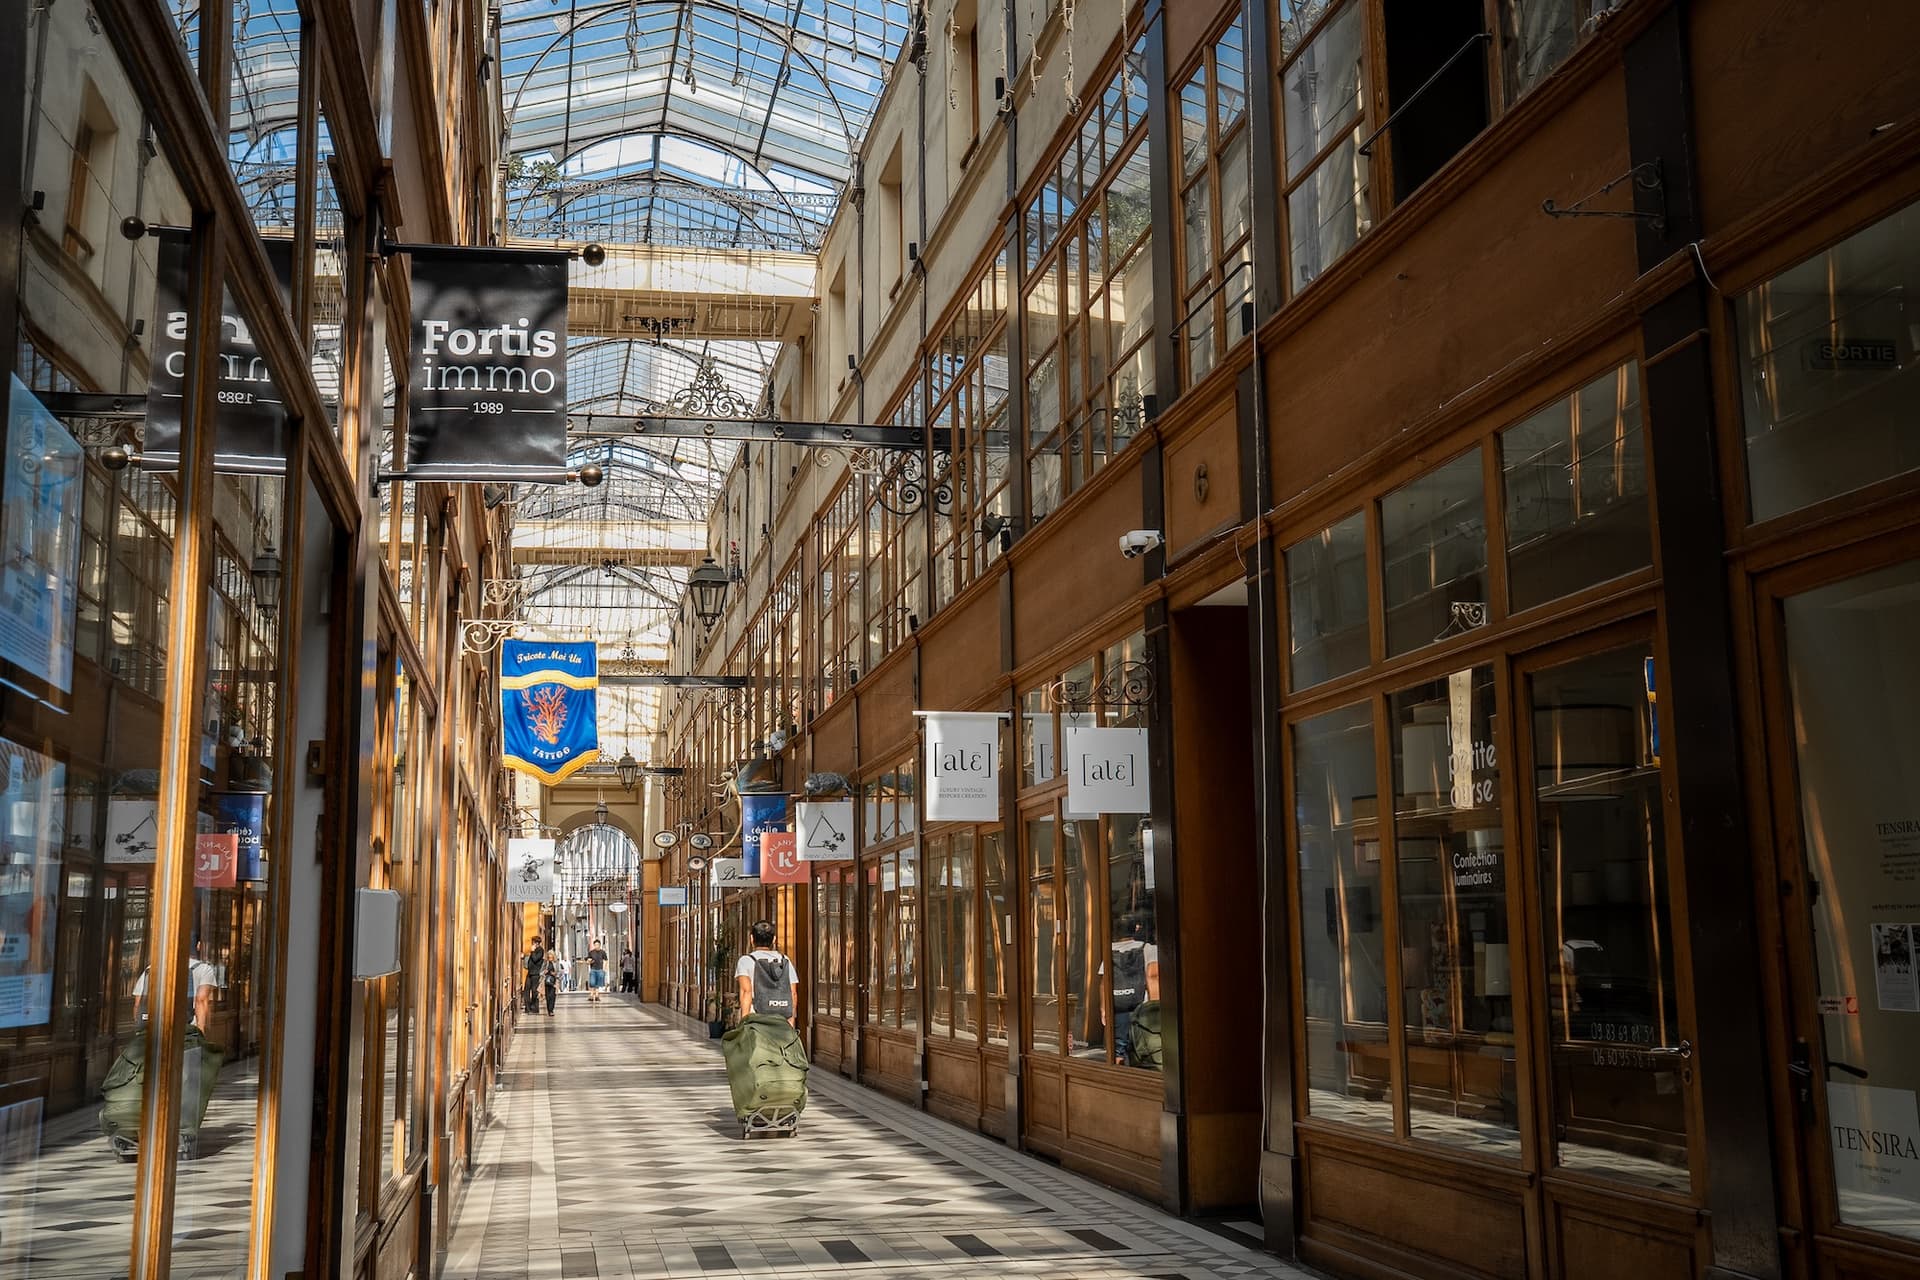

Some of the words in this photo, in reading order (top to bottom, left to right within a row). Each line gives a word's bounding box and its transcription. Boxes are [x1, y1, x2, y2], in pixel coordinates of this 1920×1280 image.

[421, 317, 557, 358] Fortis
[1822, 345, 1894, 360] SORTIE
[421, 357, 556, 394] immo
[472, 402, 504, 415] 1989
[517, 651, 546, 664] Tricote
[547, 650, 567, 661] Moi
[567, 653, 583, 664] Un
[532, 746, 570, 760] TATTOO
[1453, 851, 1498, 869] Confection
[1454, 869, 1493, 887] luminaires
[1833, 1126, 1920, 1160] TENSIRA
